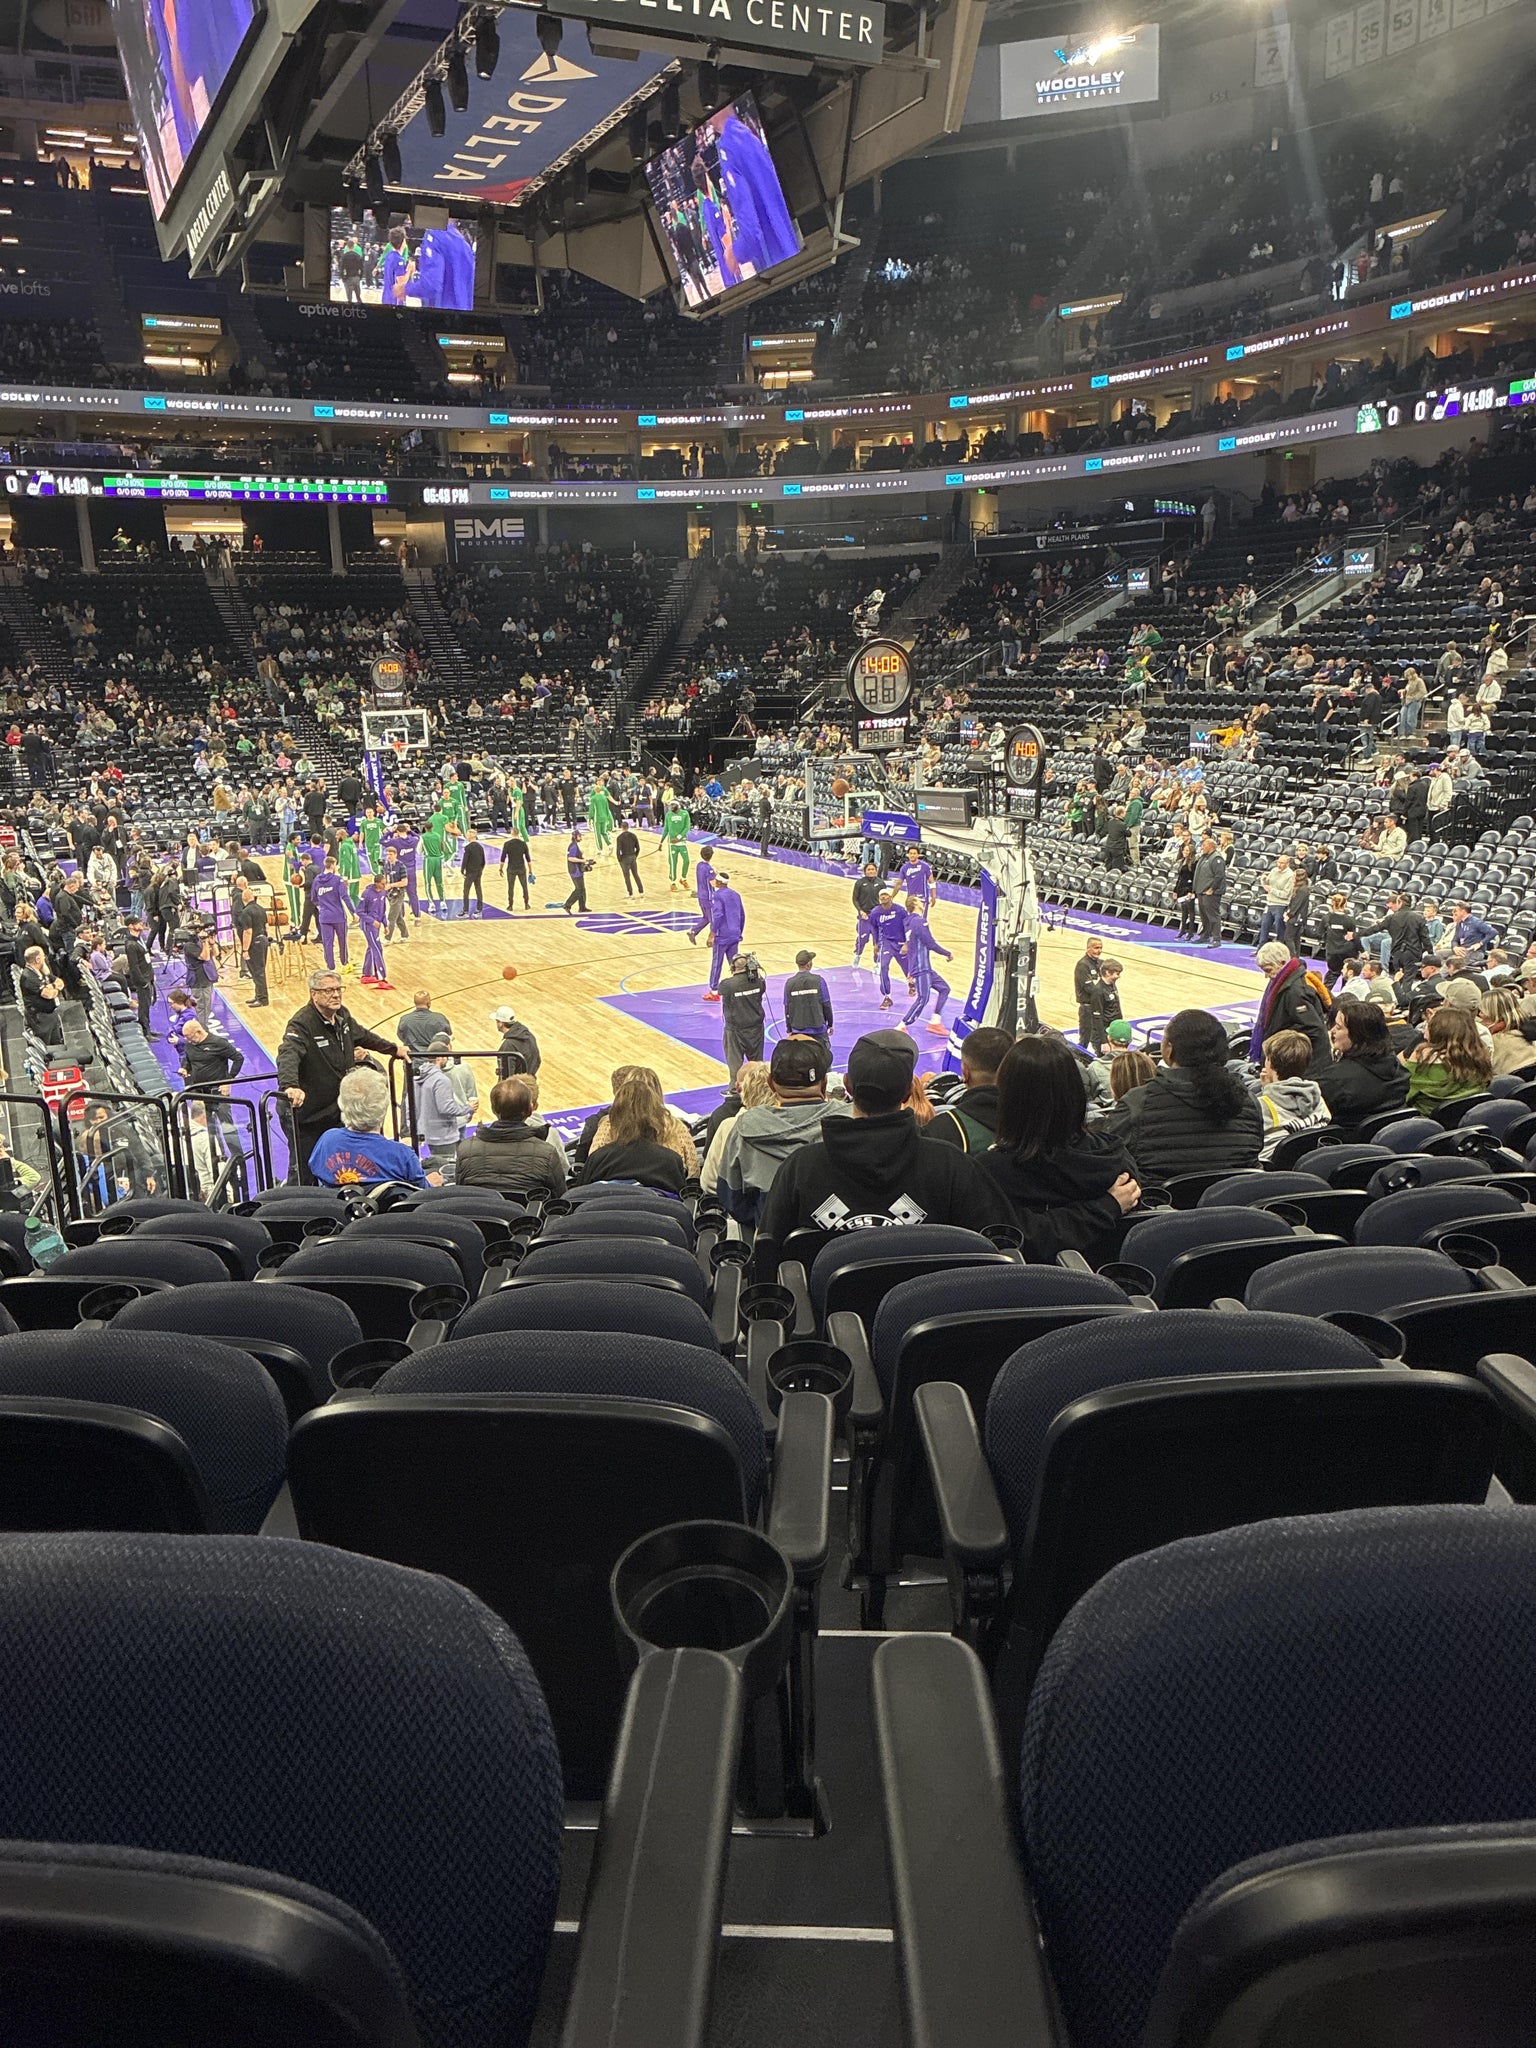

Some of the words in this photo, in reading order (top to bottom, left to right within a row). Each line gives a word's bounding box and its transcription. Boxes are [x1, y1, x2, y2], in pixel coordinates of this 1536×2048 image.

[746, 0, 873, 44] CENTER
[1393, 10, 1412, 30] 53
[1360, 22, 1379, 44] 35
[1036, 71, 1124, 93] WOODLEY
[1038, 93, 1067, 104] REAL
[1076, 86, 1121, 99] ESTATE
[433, 92, 567, 180] DELTA
[190, 207, 210, 249] DELTA
[206, 170, 230, 220] CENTER
[0, 283, 18, 294] ve
[20, 280, 51, 296] lofts
[1412, 290, 1466, 312] WOODLEY
[1469, 284, 1496, 296] REAL
[298, 302, 340, 318] aptive
[340, 304, 368, 320] lofts
[1244, 336, 1286, 354] WOODLEY
[1289, 331, 1310, 342] REAL
[1315, 321, 1349, 336] ESTATE
[1108, 368, 1152, 384] WOODLEY
[1155, 364, 1174, 374] REAL
[1178, 356, 1208, 369] ESTATE
[0, 392, 40, 402] ODLEY
[80, 396, 120, 405] ESTATE
[968, 391, 1012, 404] WOODLEY
[1015, 389, 1036, 397] REAL
[1041, 383, 1074, 394] ESTATE
[1462, 388, 1494, 413] 14:08
[1495, 395, 1508, 408] 1ST
[166, 400, 218, 410] WOODLEY
[224, 403, 249, 411] REAL
[256, 405, 292, 413] ESTATE
[334, 408, 382, 418] WOODLEY
[804, 408, 848, 418] WOODLEY
[879, 404, 912, 412] ESTATE
[1387, 406, 1400, 426] 0
[1414, 400, 1426, 422] 0
[508, 416, 554, 425] WOODLEY
[656, 416, 702, 424] WOODLEY
[733, 413, 766, 421] ESTATE
[1236, 431, 1277, 446] WOODLEY
[1280, 428, 1301, 437] REAL
[1305, 420, 1338, 434] ESTATE
[1102, 454, 1144, 468] WOODLEY
[1148, 451, 1168, 460] REAL
[1172, 446, 1201, 456] ESTATE
[964, 471, 1007, 482] WOODLEY
[1010, 468, 1031, 477] REAL
[1036, 465, 1068, 474] ESTATE
[6, 475, 18, 494] 0
[56, 476, 89, 495] 14:08
[162, 489, 174, 497] 0/0
[656, 489, 700, 498] WOODLEY
[801, 484, 846, 493] WOODLEY
[876, 480, 909, 488] ESTATE
[452, 488, 470, 504] PM
[454, 518, 525, 538] SME
[1048, 534, 1070, 543] HEALTH
[1070, 533, 1090, 541] PLANS
[873, 717, 908, 729] TISSOT
[1015, 742, 1037, 758] 14:08
[971, 946, 987, 1011] AMERICA
[980, 904, 990, 945] FIRST
